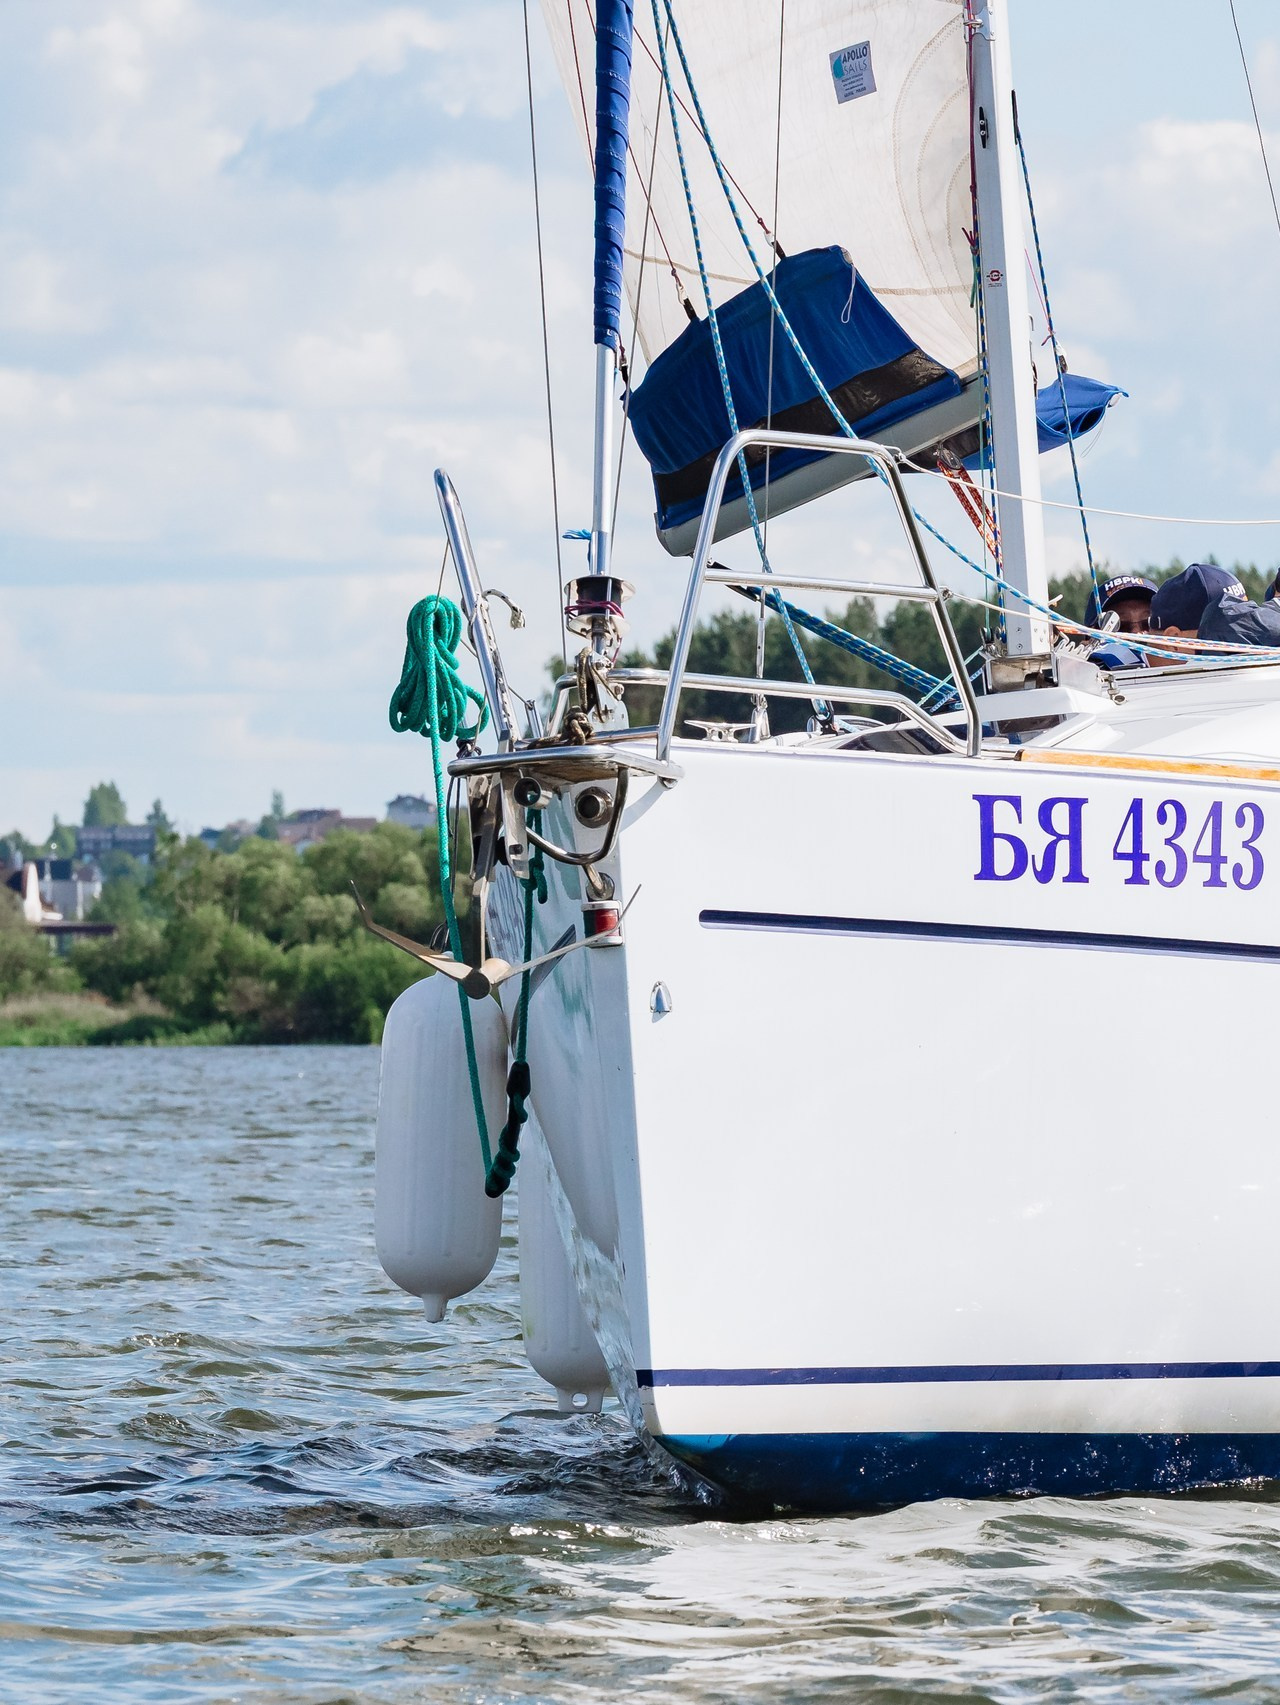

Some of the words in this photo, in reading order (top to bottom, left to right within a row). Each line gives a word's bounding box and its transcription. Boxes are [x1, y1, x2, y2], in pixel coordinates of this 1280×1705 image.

[842, 45, 868, 64] APOLLO
[843, 59, 868, 75] SAILS
[972, 794, 1089, 884] БЯ
[1113, 798, 1264, 890] 4343
